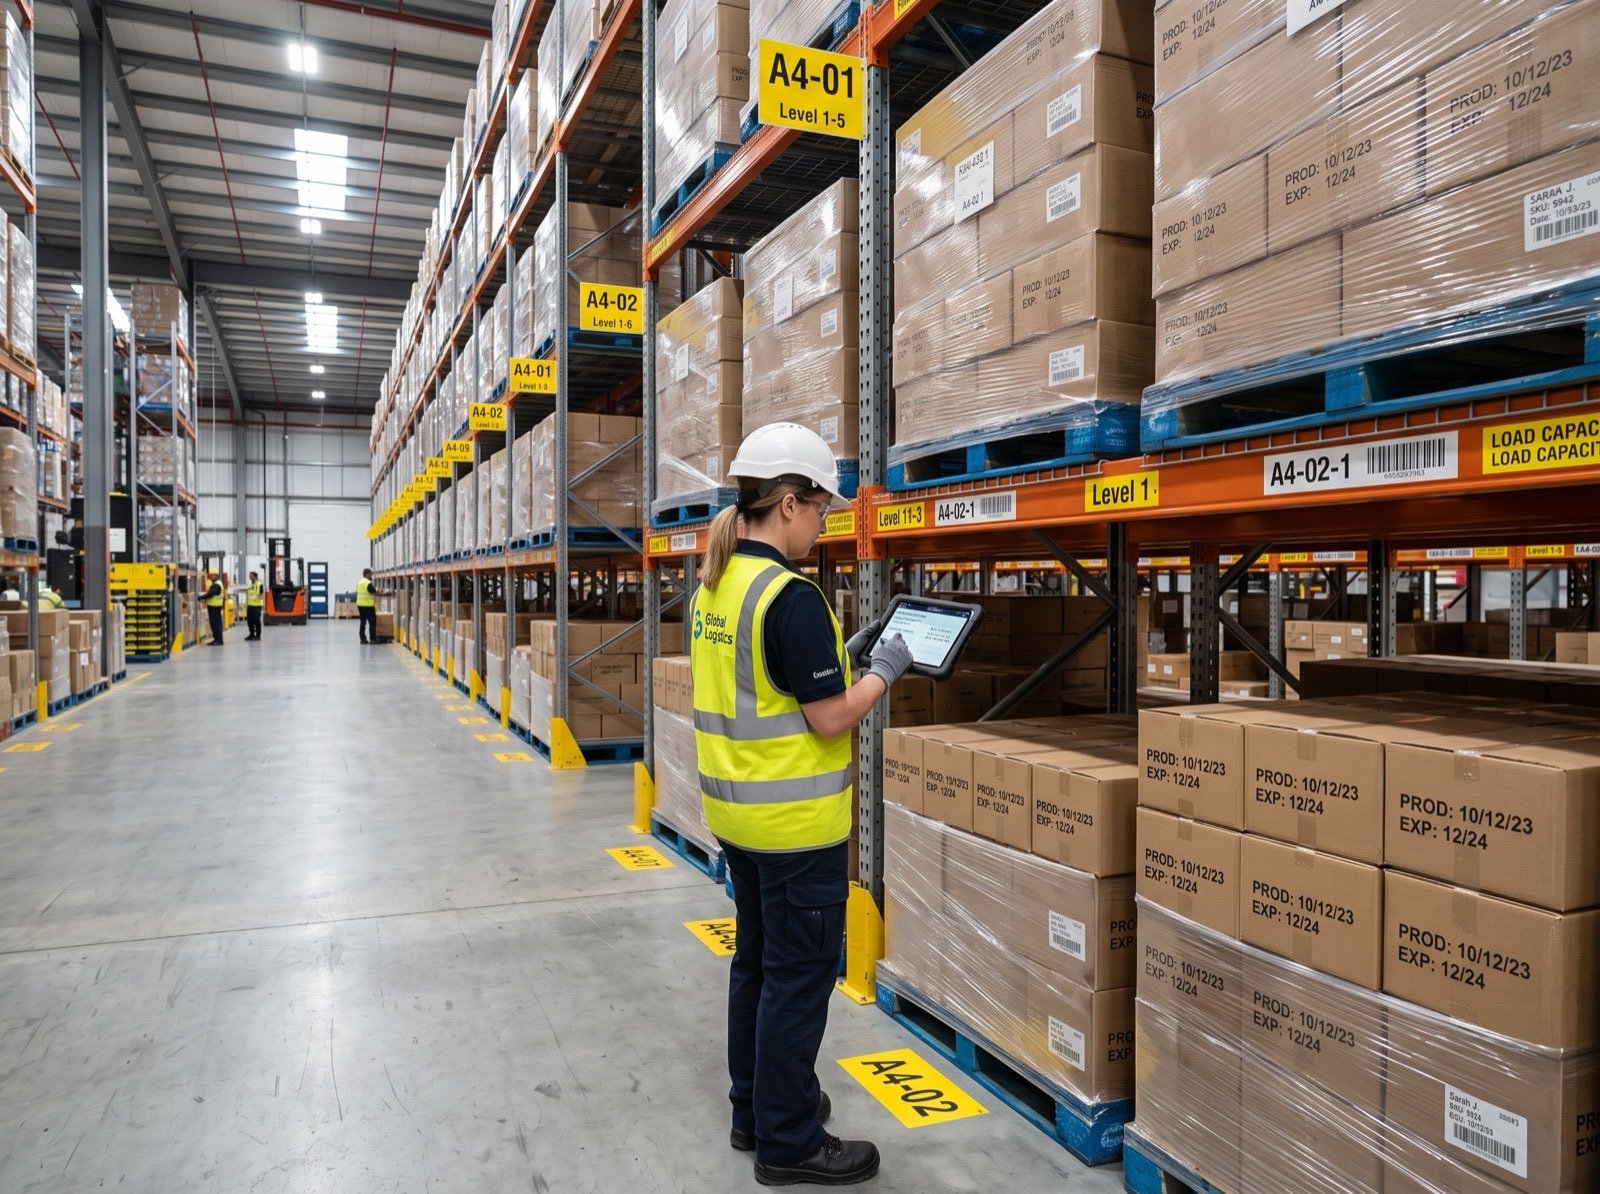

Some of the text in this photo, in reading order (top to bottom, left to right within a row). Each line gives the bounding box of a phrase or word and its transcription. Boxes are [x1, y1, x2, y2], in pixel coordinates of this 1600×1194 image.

[1163, 0, 1228, 44] PROD: 10/12/2
[1163, 17, 1215, 61] EXP: 12/24
[769, 52, 854, 98] A4-01
[1450, 49, 1573, 113] PROD: 10/12/23
[1509, 81, 1551, 111] 12/24
[779, 102, 846, 129] Level 1-5
[1285, 139, 1372, 187] PROD: 10/12/23
[1285, 165, 1356, 205] EXP: 12/24
[1162, 202, 1227, 239] PROD: 10/12/23
[1162, 224, 1215, 255] EXP: 12/24
[586, 290, 638, 312] A4-02
[593, 316, 632, 329] Level 1-6
[1165, 302, 1228, 332] PROD: 10/12/23
[1197, 322, 1217, 338] 12/24
[514, 363, 551, 378] A4-01
[519, 382, 536, 390] Level
[472, 406, 503, 419] A4-02
[1492, 429, 1535, 448] LOAD
[1270, 453, 1350, 487] A4-02-1
[1492, 449, 1531, 467] LOAD
[1093, 479, 1134, 505] Level
[879, 507, 900, 527] Level
[938, 500, 975, 521] A4-02-1
[705, 612, 727, 627] Global
[704, 628, 733, 645] Logistics
[926, 769, 944, 783] PROD:
[1147, 748, 1226, 776] PROD: 10/12/23
[940, 785, 956, 799] 12/24
[1147, 766, 1200, 789] EXP: 12/24
[1256, 768, 1359, 800] PROD: 10/12/23
[977, 783, 1025, 806] PROD: 10/12/23
[977, 796, 1009, 815] EXP: 12/24
[1256, 787, 1324, 815] EXP: 12/24
[1036, 799, 1093, 827] PROD: 10/12/23
[1036, 814, 1074, 836] EXP: 12/24
[1400, 793, 1533, 835] PROD: 10/12/23
[1400, 815, 1488, 849] EXP: 12/24
[1145, 847, 1224, 885] PROD: 10/12/23
[1145, 865, 1198, 894] EXP: 12/24
[1252, 899, 1320, 935] EXP: 12/24
[1253, 880, 1354, 925] PROD: 10/12/23
[1398, 923, 1531, 980] PROD: 10/12/23
[1145, 945, 1224, 991] PROD: 10/12/23
[1145, 962, 1198, 997] EXP: 12/24
[1398, 945, 1486, 989] EXP: 12/24
[1253, 991, 1355, 1048] PROD: 10/12/23
[1253, 1010, 1322, 1054] EXP: 12/24
[861, 1060, 959, 1118] A4-02
[1449, 1091, 1480, 1111] Sarah J.
